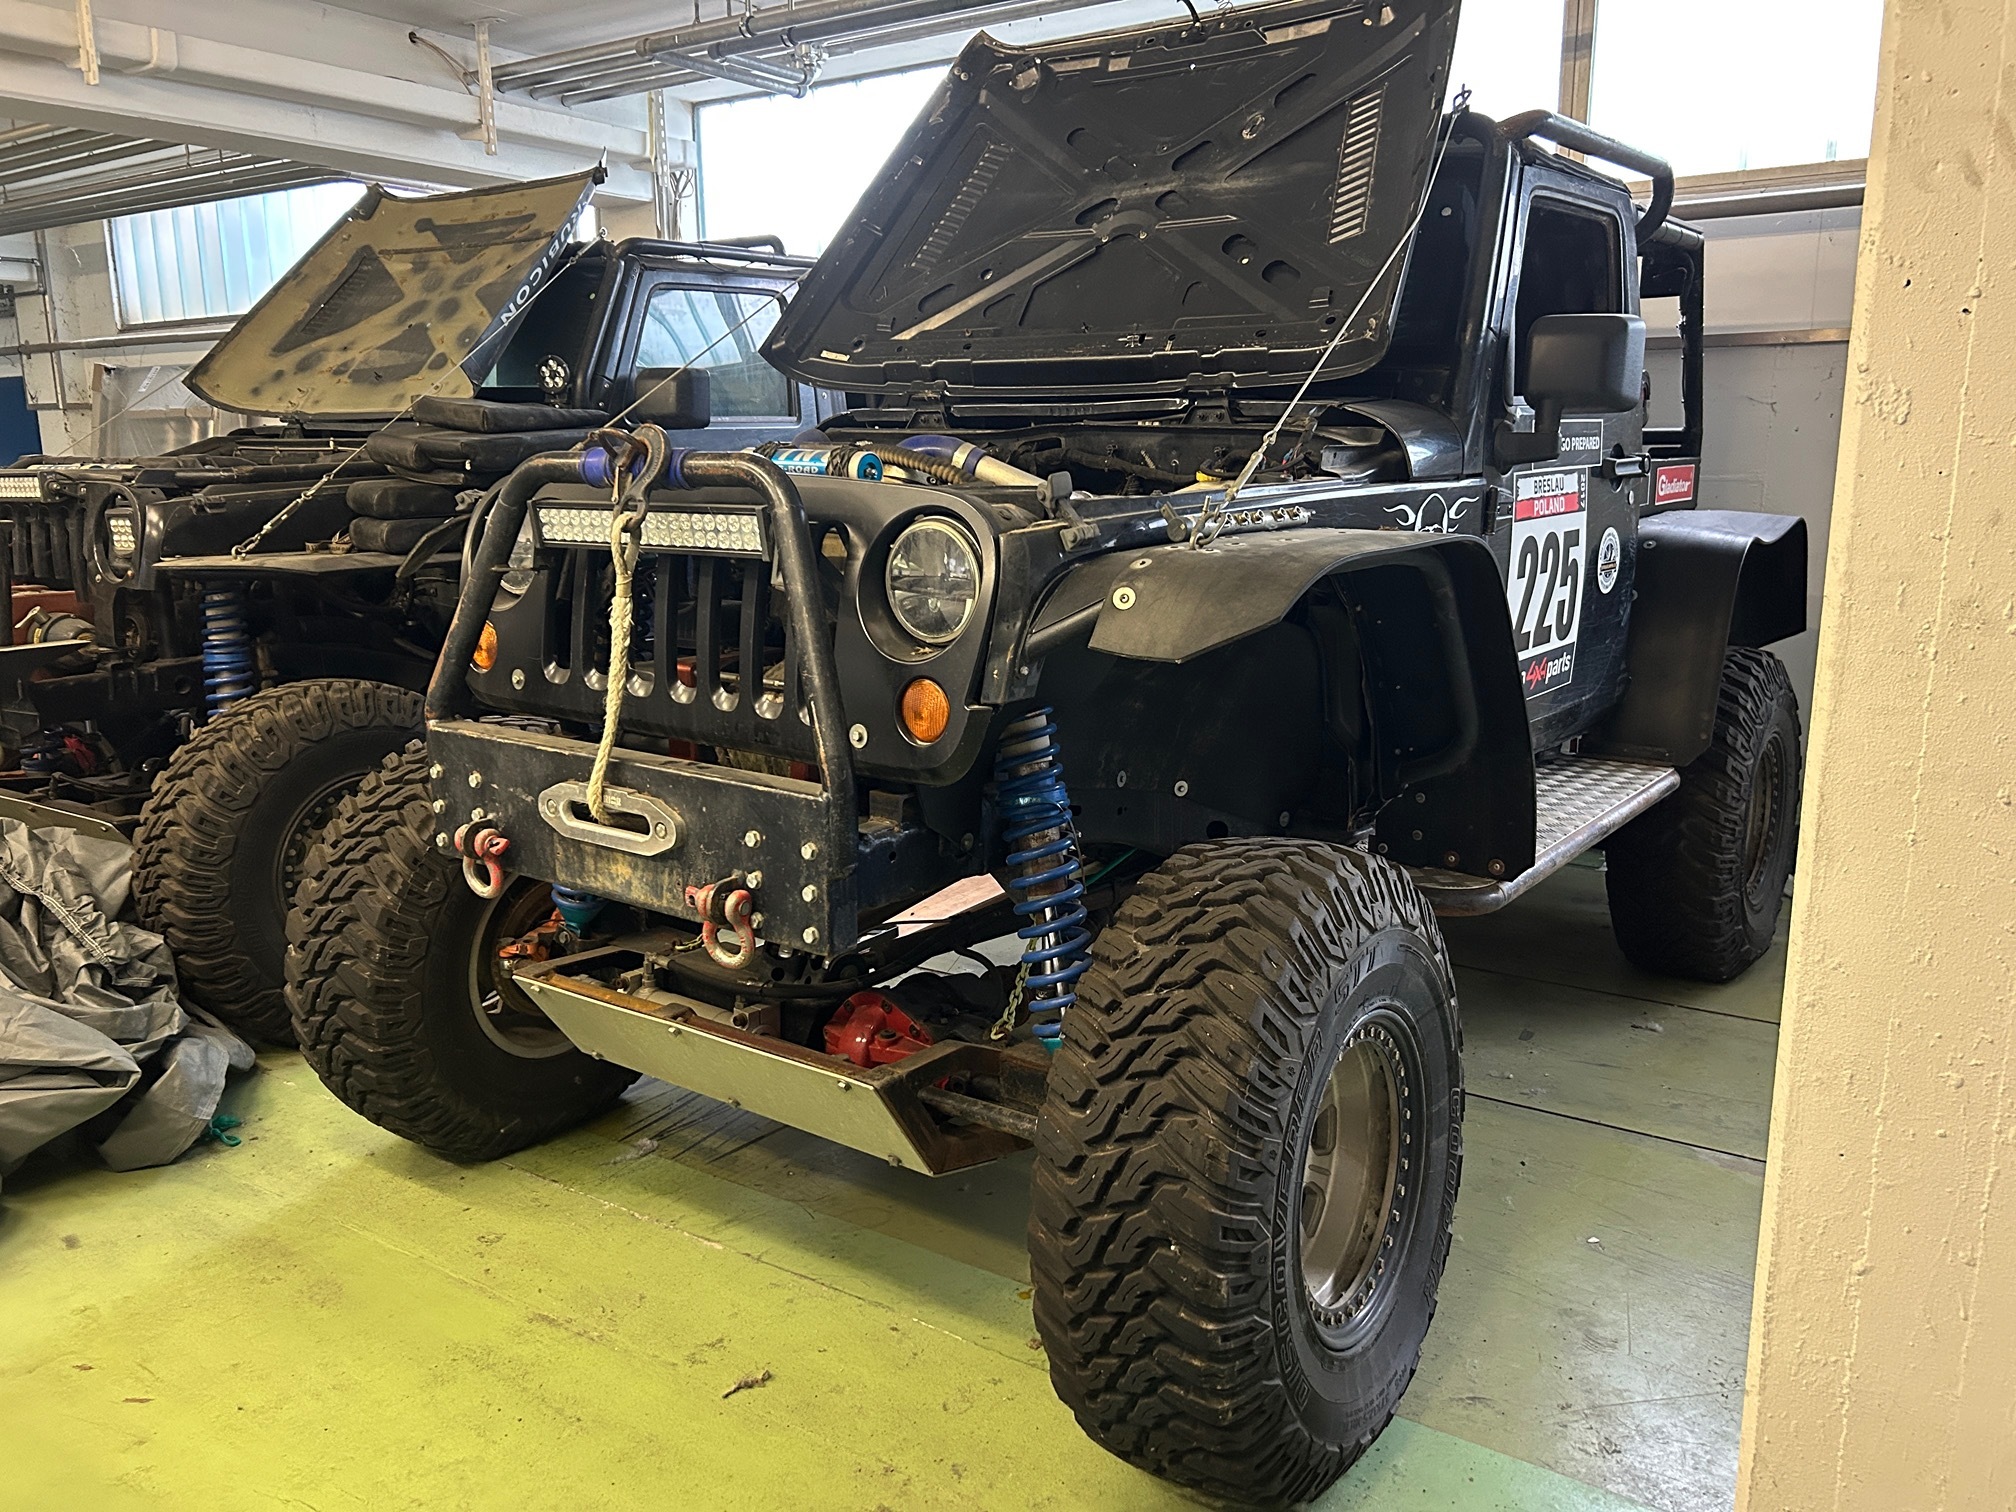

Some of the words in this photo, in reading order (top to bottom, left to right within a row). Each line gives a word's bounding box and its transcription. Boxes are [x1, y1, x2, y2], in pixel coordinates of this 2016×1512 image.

[1571, 436, 1600, 451] PREPARED
[1533, 477, 1565, 495] BRESLAU
[1658, 474, 1692, 497] Gladiator
[1533, 496, 1566, 517] POLAND
[1513, 529, 1580, 652] 225
[1423, 1086, 1463, 1308] COOPER
